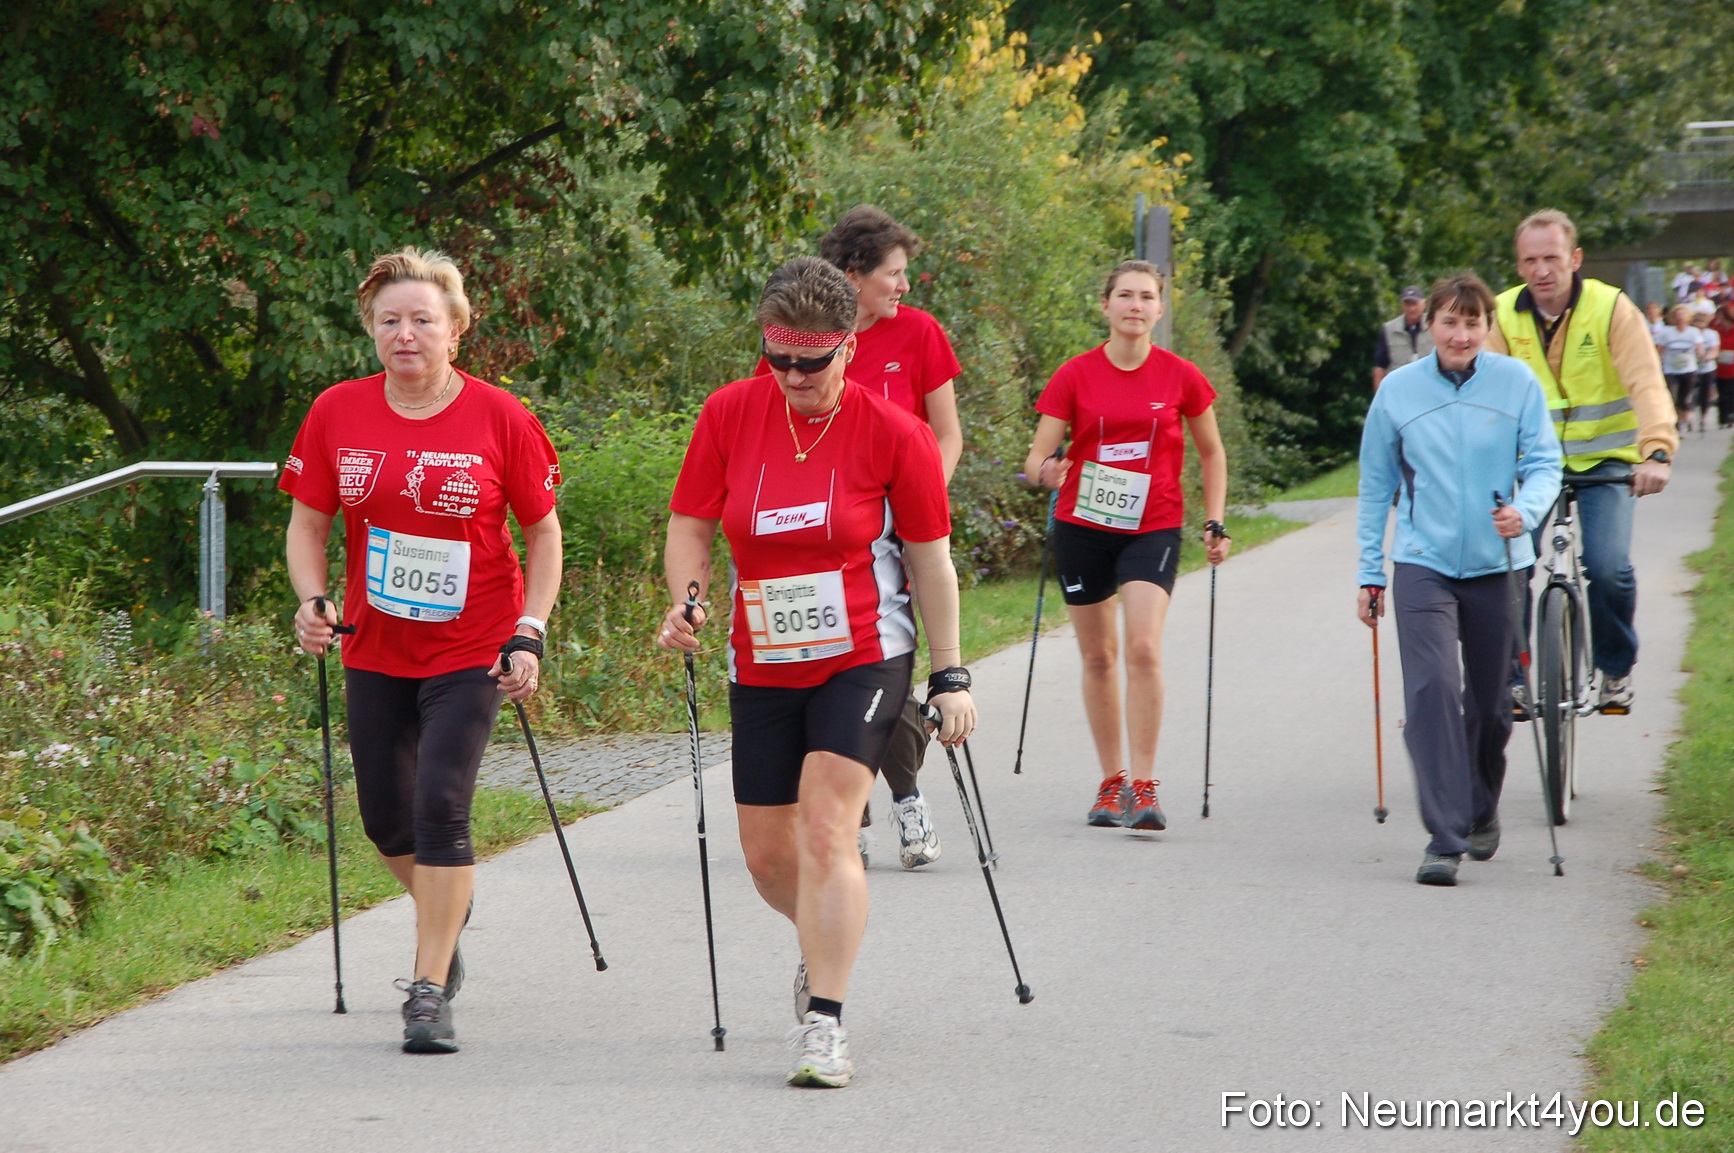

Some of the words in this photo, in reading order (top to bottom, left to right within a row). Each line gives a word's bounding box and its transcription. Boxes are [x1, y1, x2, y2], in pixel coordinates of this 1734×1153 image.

[405, 449, 419, 459] 11.
[420, 450, 484, 466] NEUMARKTER
[1112, 448, 1135, 456] DEHN
[340, 456, 374, 466] IMMER
[416, 458, 473, 469] STADTLAUF
[339, 474, 368, 487] NEU
[1098, 469, 1128, 486] Carina
[438, 493, 480, 505] 19.09.2010
[1095, 488, 1140, 510] 8057
[775, 511, 807, 526] DEHN
[393, 539, 450, 563] Susanne
[392, 566, 458, 596] 8055
[765, 583, 816, 603] Brigitte
[773, 605, 837, 634] 8056
